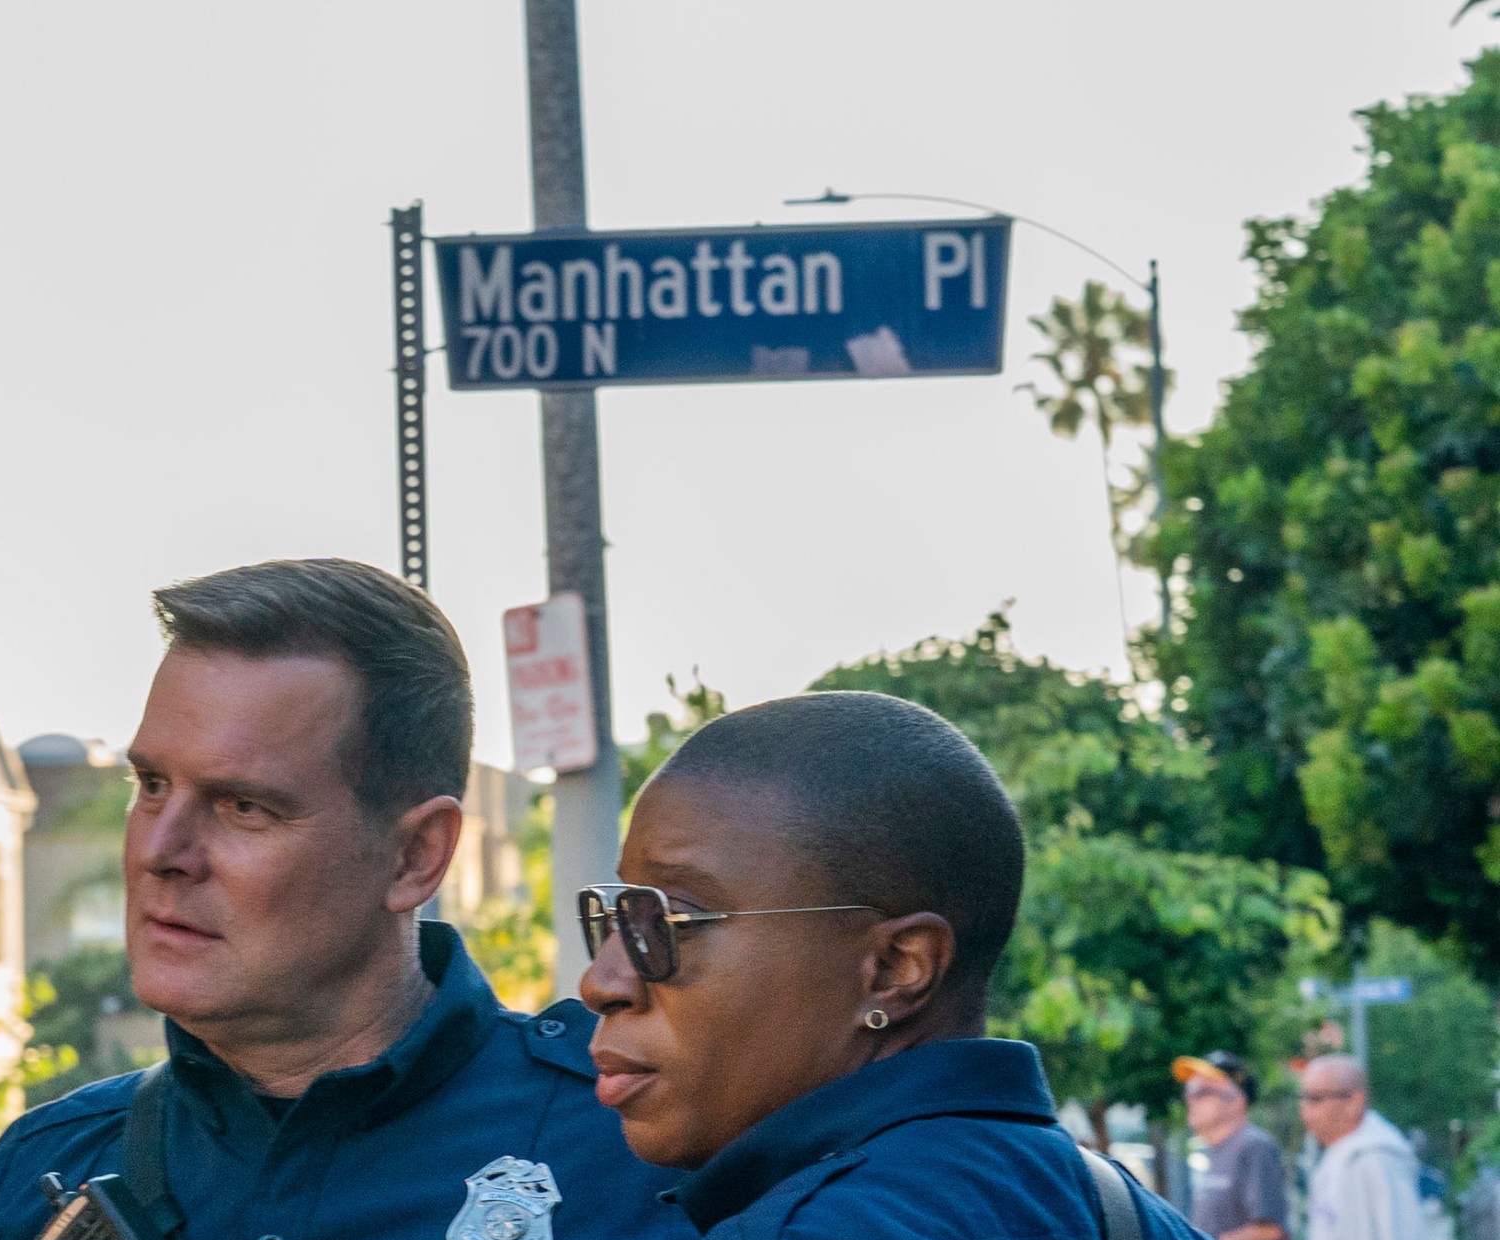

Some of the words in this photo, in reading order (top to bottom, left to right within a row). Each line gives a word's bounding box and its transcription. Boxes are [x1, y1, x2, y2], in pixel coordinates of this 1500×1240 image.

[457, 242, 844, 323] Manhattan
[922, 230, 988, 311] Pl
[460, 324, 560, 380] 700
[582, 322, 617, 377] N
